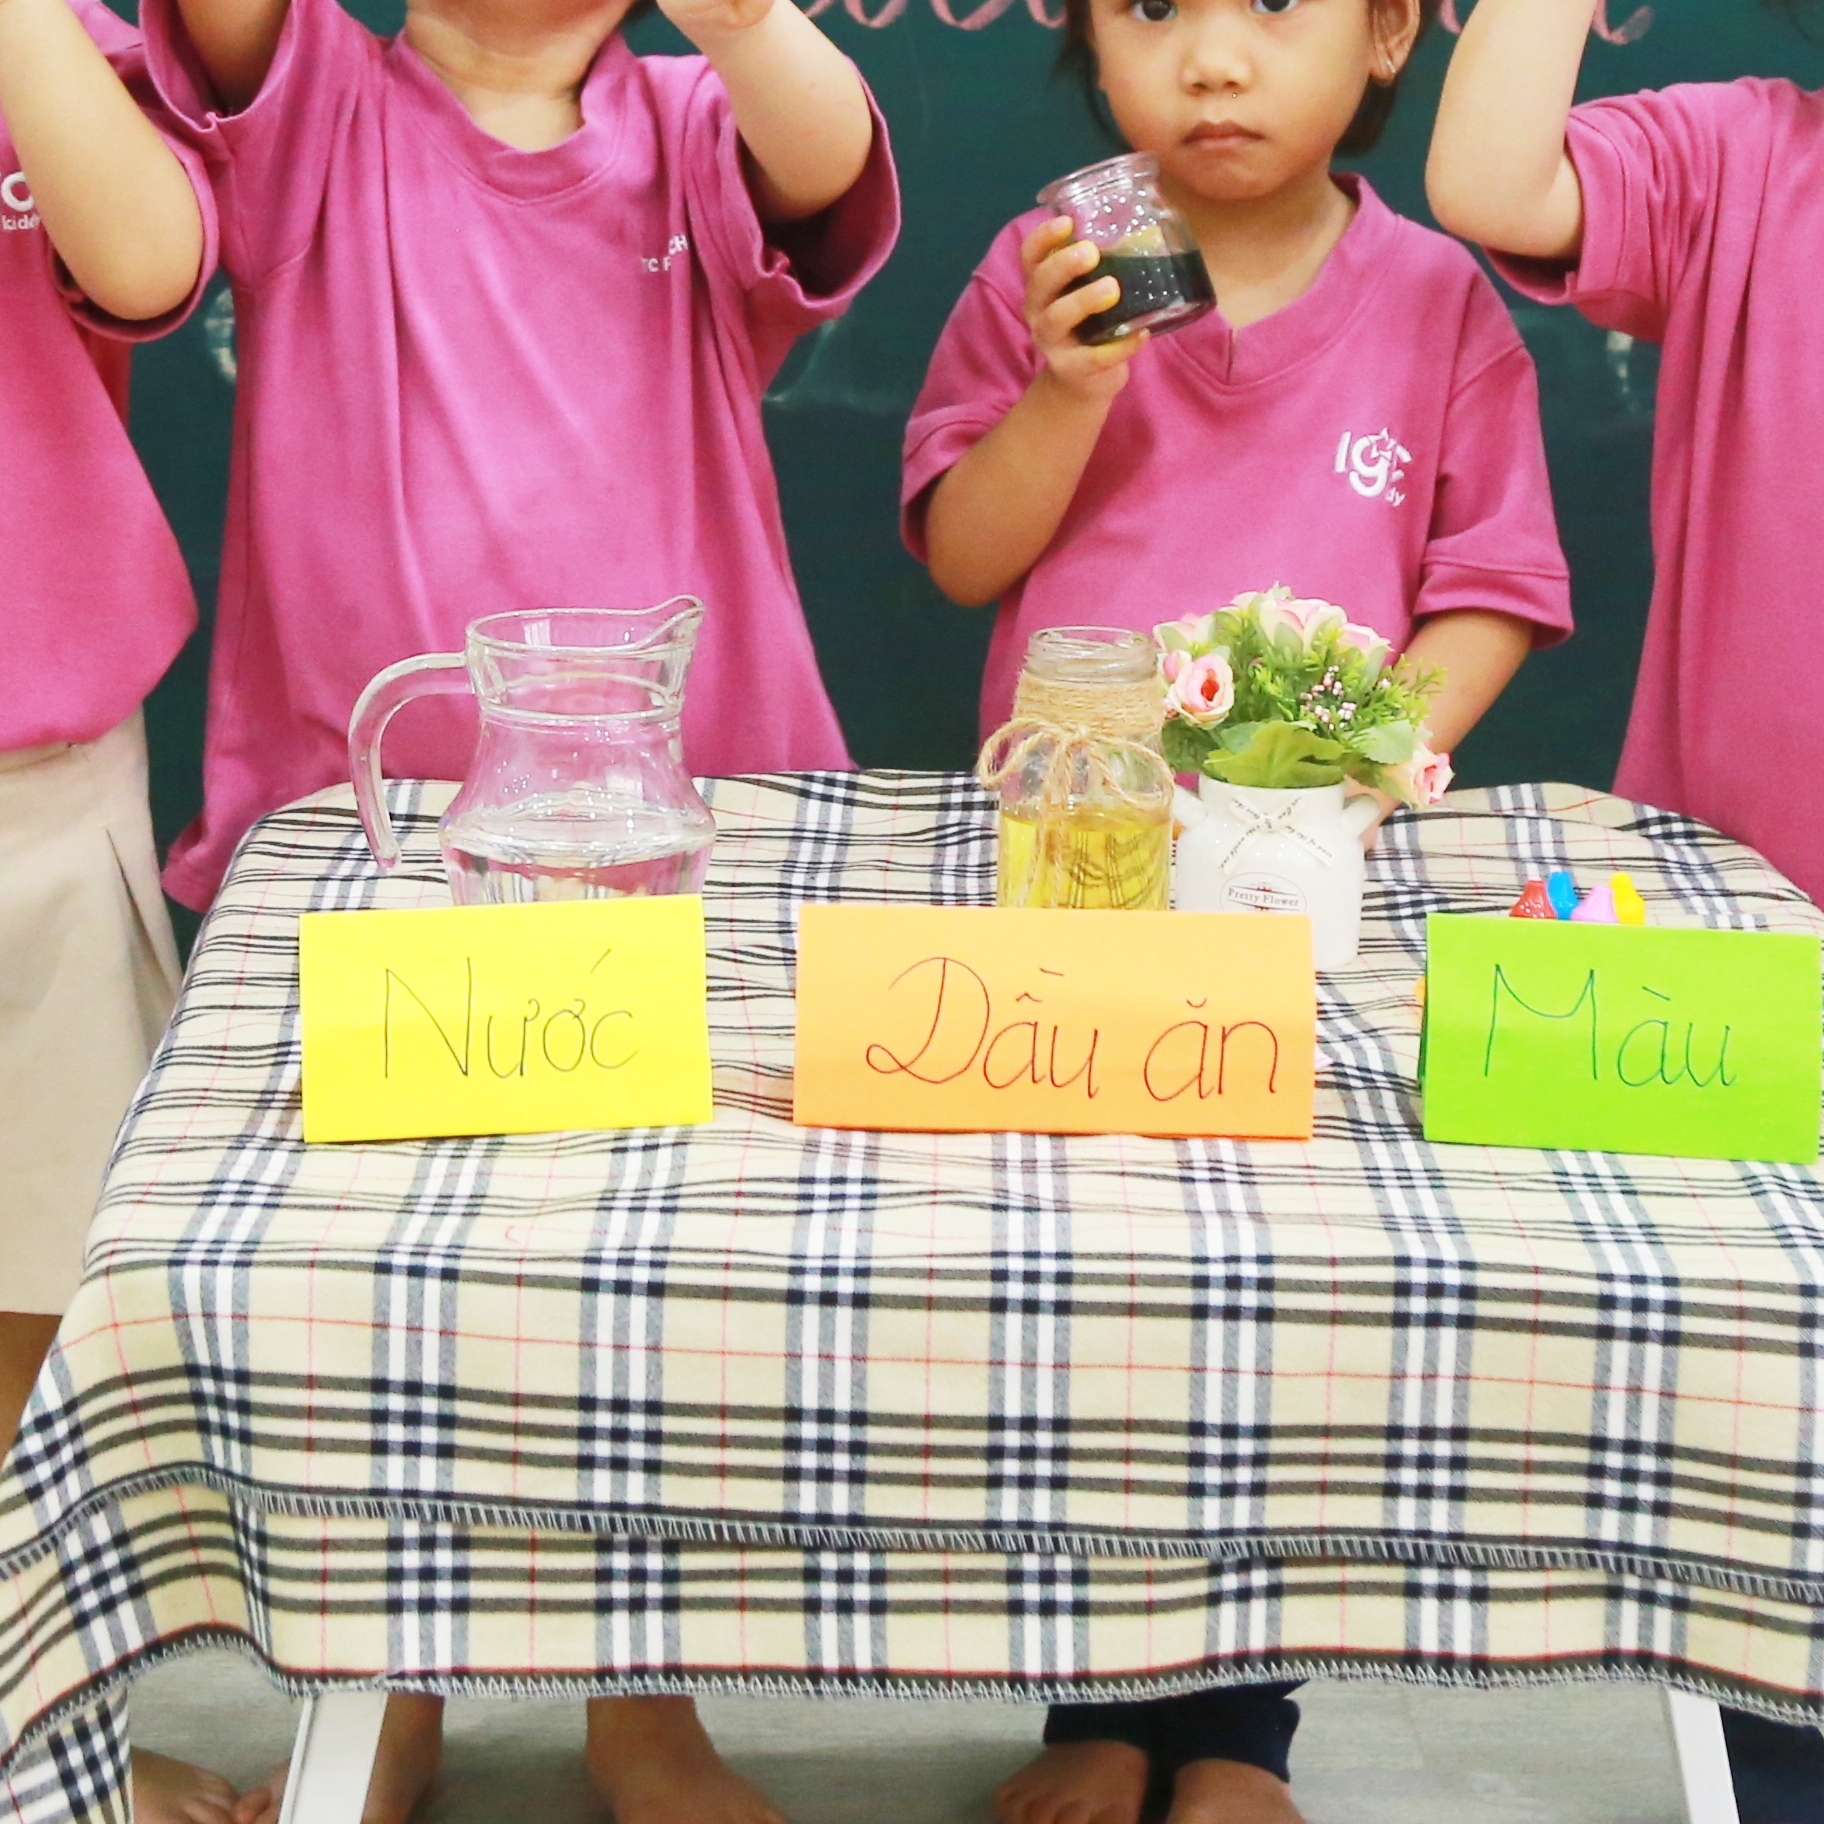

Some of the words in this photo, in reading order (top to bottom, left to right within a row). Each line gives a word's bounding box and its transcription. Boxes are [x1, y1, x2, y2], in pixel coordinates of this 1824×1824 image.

[1228, 887, 1260, 904] Pretty
[1263, 894, 1299, 907] Flower
[383, 948, 639, 1080] Nước
[865, 955, 1101, 1100] Dầu
[1143, 996, 1277, 1103] ăn
[1483, 961, 1739, 1089] Màu
